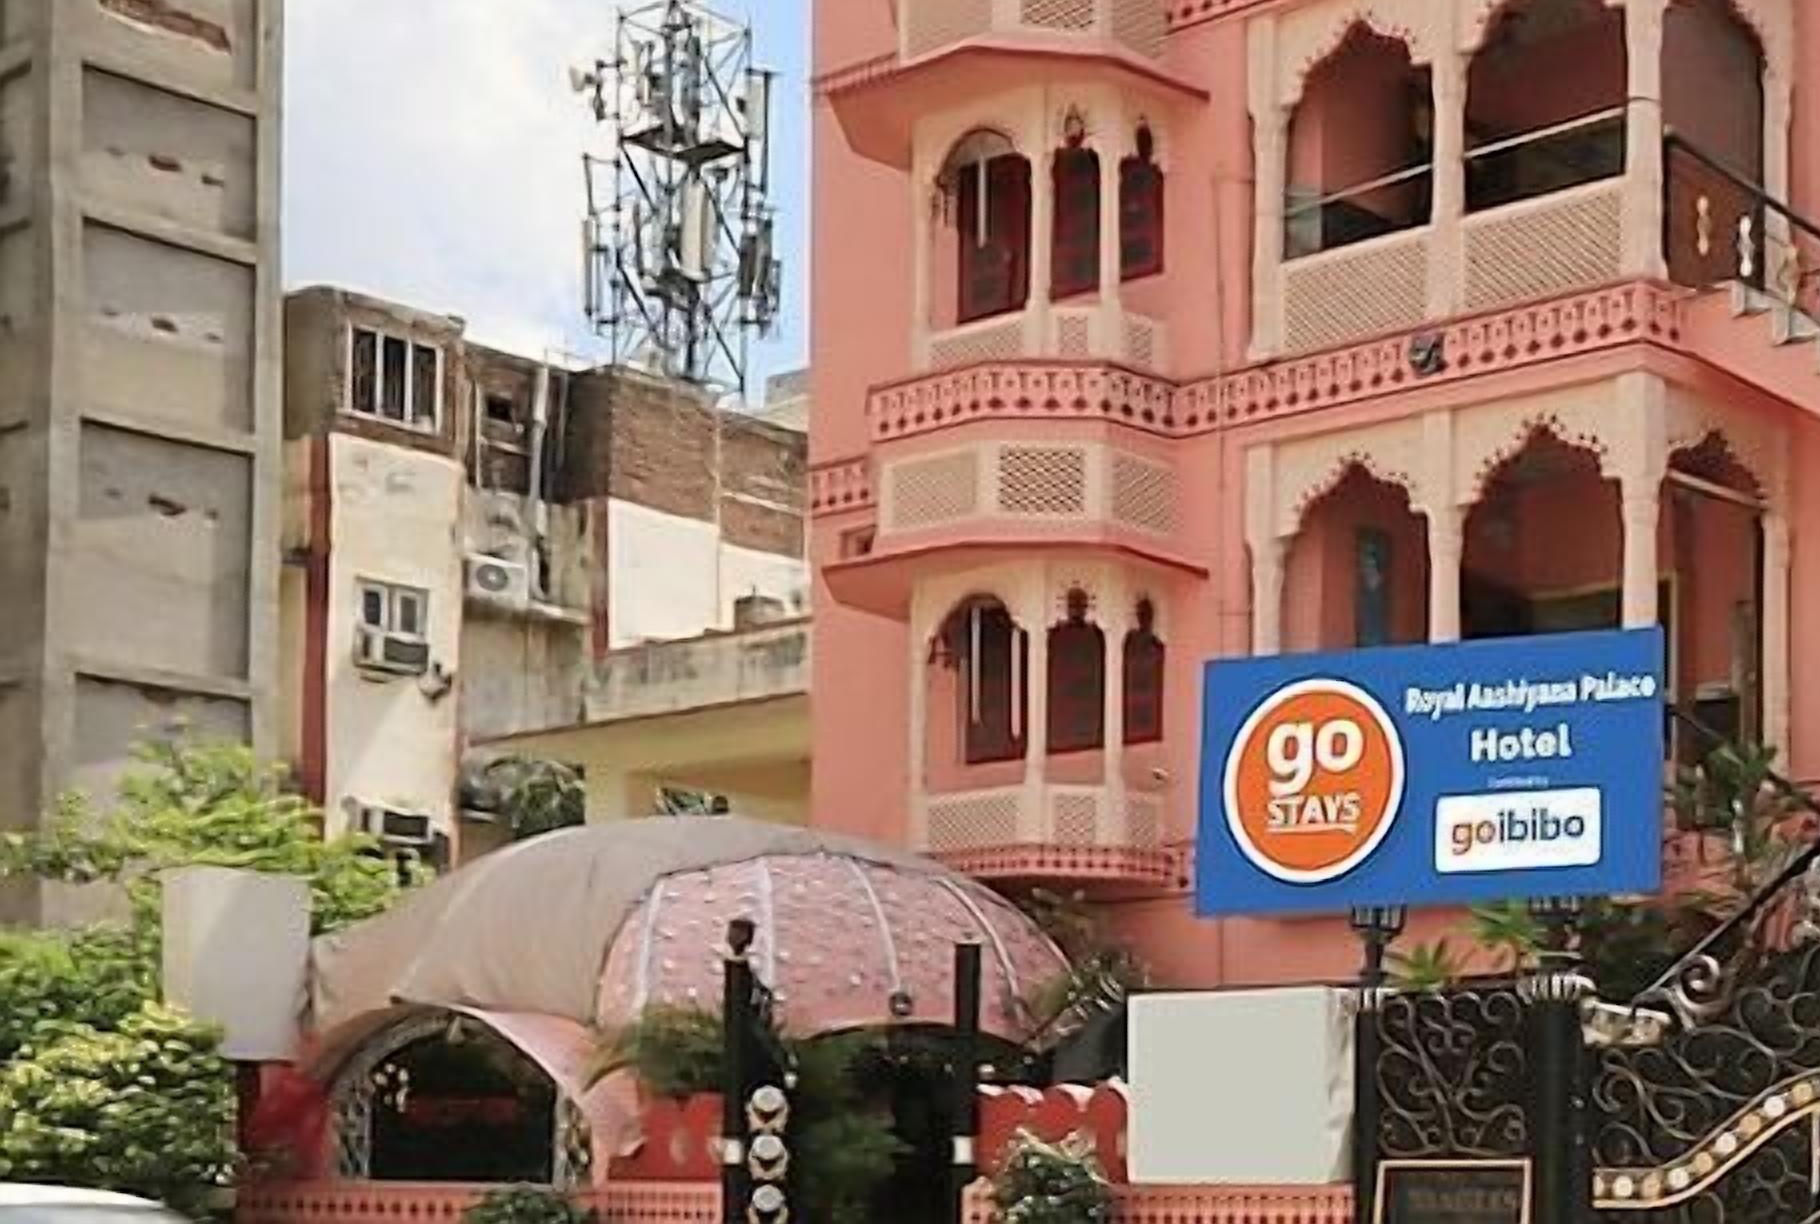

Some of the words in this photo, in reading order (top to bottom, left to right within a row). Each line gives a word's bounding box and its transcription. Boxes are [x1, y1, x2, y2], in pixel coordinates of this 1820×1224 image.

[1406, 683, 1465, 721] Royal
[1468, 679, 1577, 713] Aashiyana
[1580, 671, 1656, 702] Palace
[1267, 719, 1364, 797] go
[1471, 723, 1573, 762] Hotel
[1267, 792, 1361, 826] STAYS
[1452, 807, 1585, 856] goibibo
